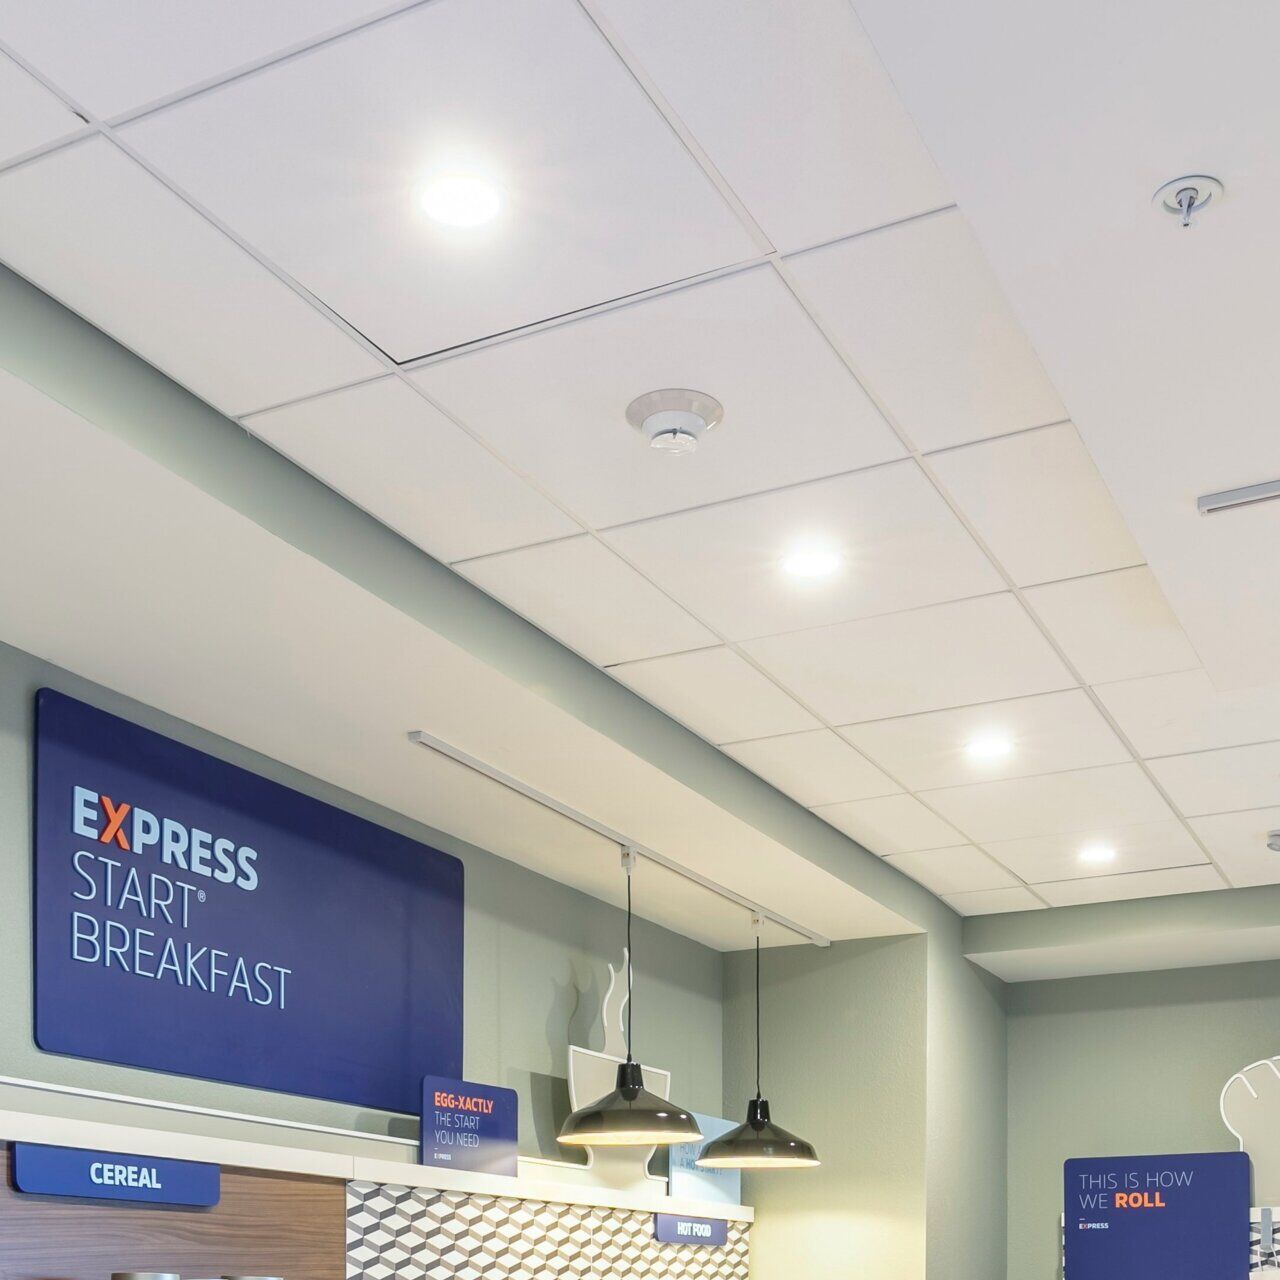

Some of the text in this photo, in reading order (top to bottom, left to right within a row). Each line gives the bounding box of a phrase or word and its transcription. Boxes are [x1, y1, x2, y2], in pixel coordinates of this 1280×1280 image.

[72, 785, 259, 891] EXPRESS
[72, 911, 292, 1010] BREAKFAST
[434, 1091, 494, 1114] EGG-XACTLY
[434, 1110, 480, 1130] THE START
[434, 1129, 480, 1148] YOU NEED
[89, 1161, 162, 1190] CEREAL
[1078, 1170, 1193, 1189] THIS IS HOW
[1078, 1191, 1166, 1209] WE ROLL
[677, 1221, 712, 1237] HOT FOOD
